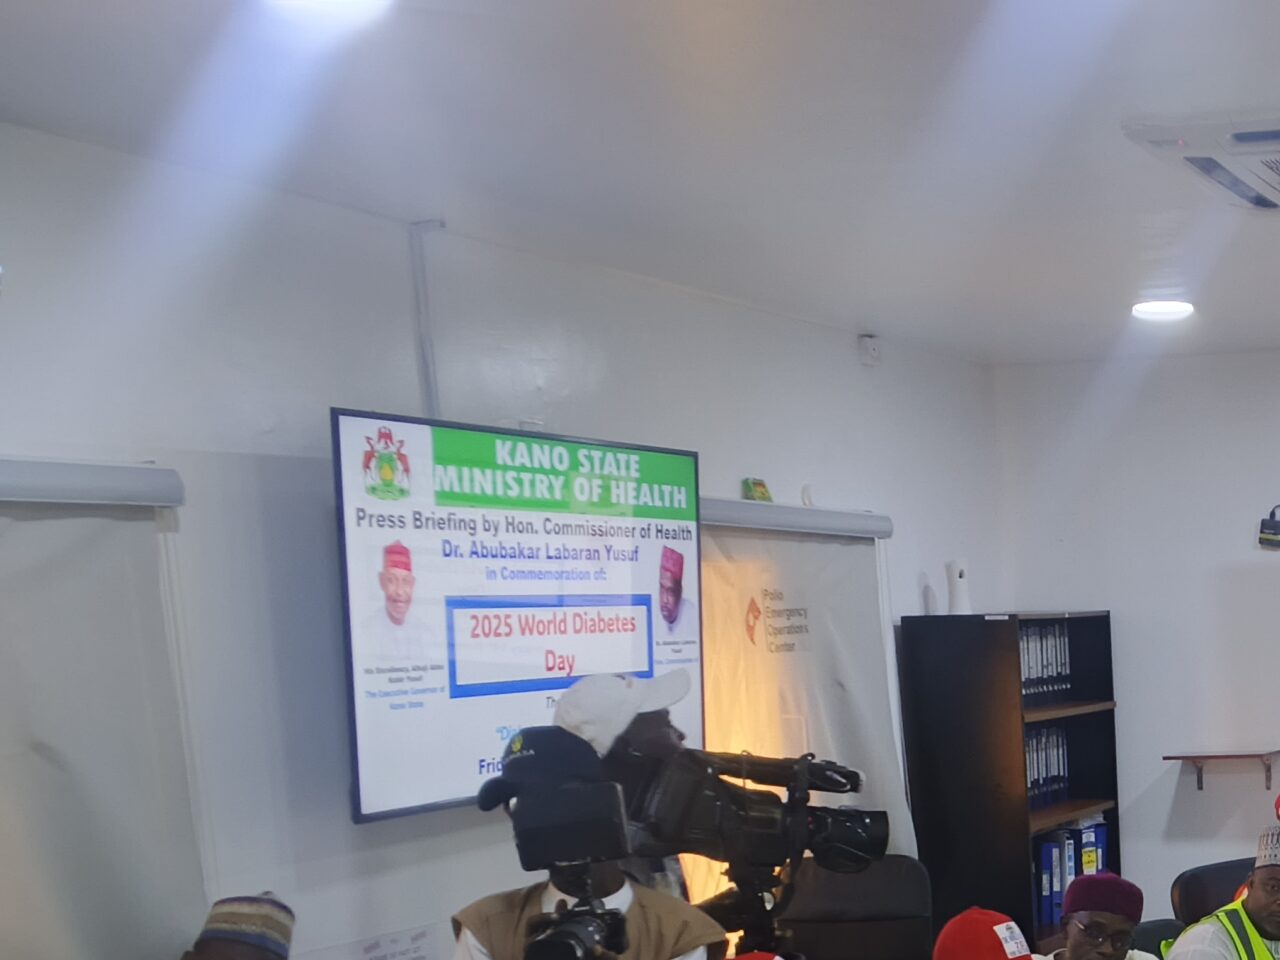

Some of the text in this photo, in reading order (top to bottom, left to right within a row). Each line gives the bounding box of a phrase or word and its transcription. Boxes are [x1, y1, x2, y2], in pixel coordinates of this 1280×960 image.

[495, 439, 641, 478] KANO STATE
[435, 464, 687, 508] MINISTRY OF HEALTH
[356, 508, 692, 541] Press Briefing by Hon. Commissioner of Health
[441, 539, 639, 562] Dr. Abubakar Labaran Yusuf
[486, 566, 607, 582] in Commemoration of:
[762, 587, 784, 601] Polio
[470, 610, 636, 639] 2025 World Diabetes
[766, 605, 808, 621] Emergency
[767, 623, 809, 636] Operations
[769, 641, 796, 654] Center
[545, 649, 576, 677] Day
